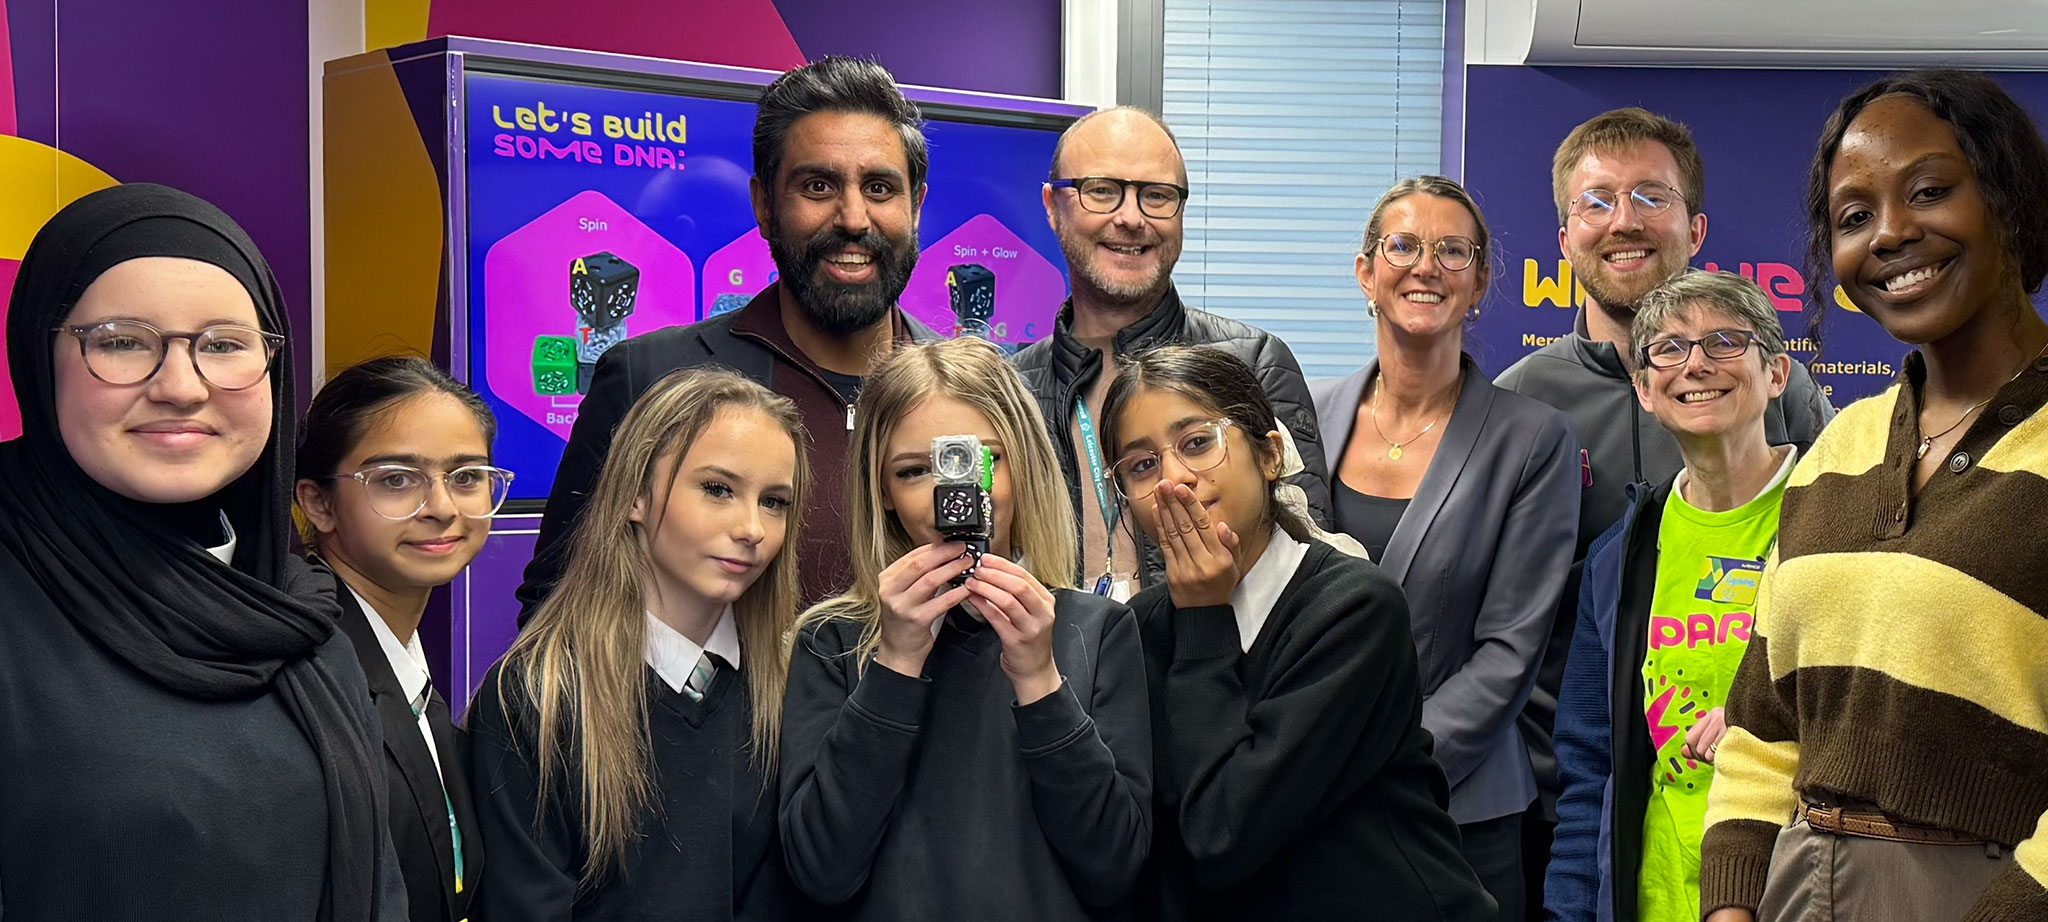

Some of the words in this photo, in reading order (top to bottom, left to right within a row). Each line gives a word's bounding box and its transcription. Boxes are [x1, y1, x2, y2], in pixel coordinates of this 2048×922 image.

[493, 101, 592, 136] Let's
[603, 111, 686, 144] Build
[614, 143, 685, 170] DNA:
[578, 217, 608, 232] Spin
[953, 244, 977, 258] Spin
[992, 246, 1018, 258] Glow
[571, 257, 588, 275] A
[728, 268, 743, 286] G
[945, 270, 958, 286] A
[579, 327, 593, 345] T
[1024, 322, 1037, 338] C
[1522, 333, 1567, 347] Mer
[1810, 360, 1897, 378] materials,
